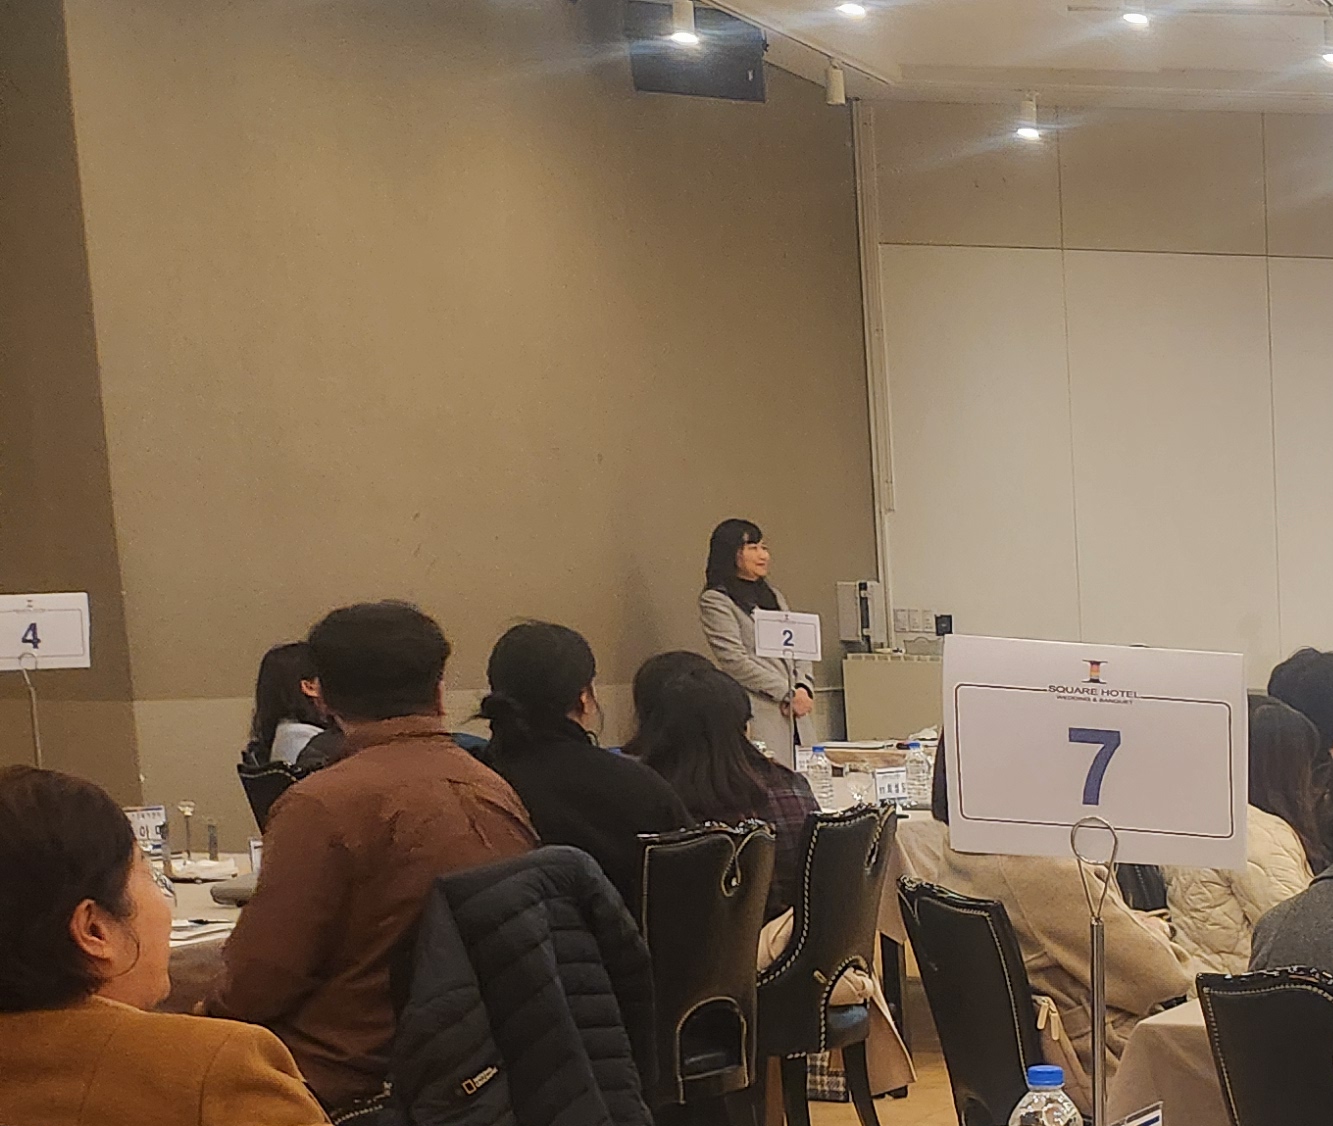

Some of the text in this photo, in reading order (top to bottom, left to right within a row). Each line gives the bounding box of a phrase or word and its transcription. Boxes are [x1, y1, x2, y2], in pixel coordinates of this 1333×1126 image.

[21, 622, 42, 650] 4
[782, 629, 795, 647] 2
[1048, 685, 1141, 699] SQUARE HOTEL
[1068, 726, 1122, 807] 7
